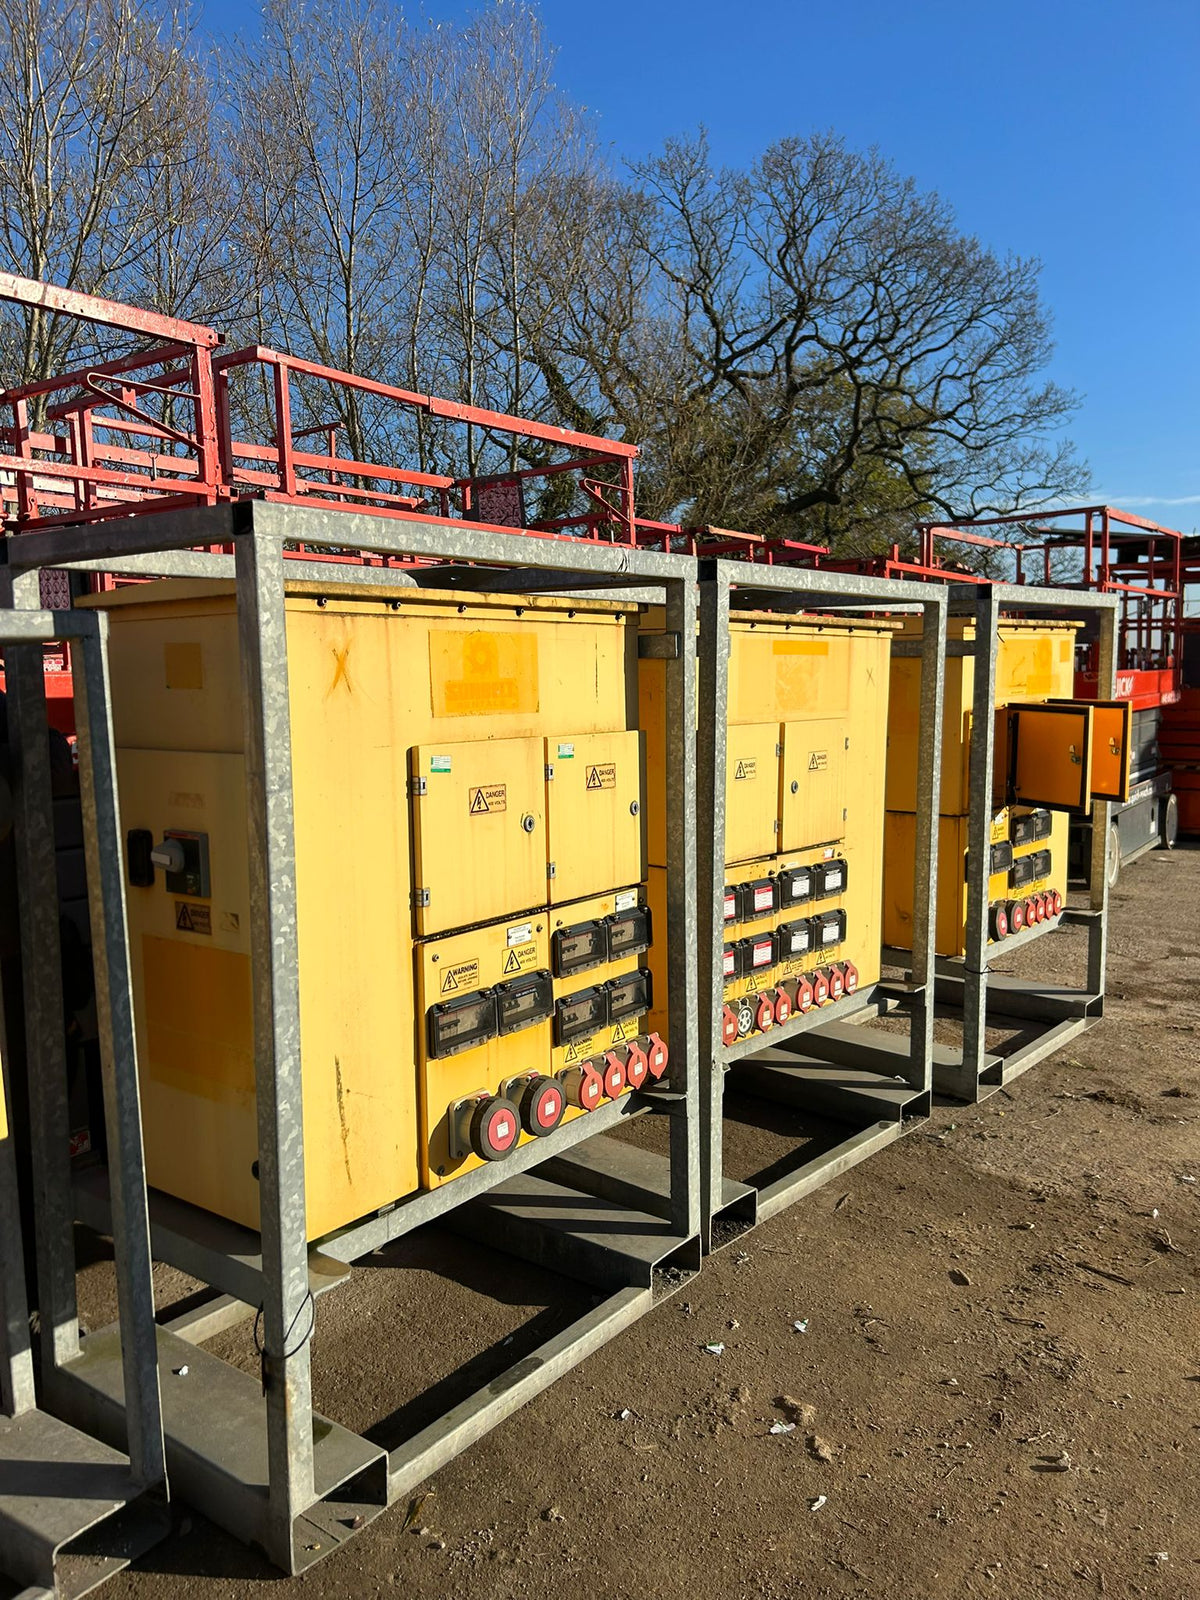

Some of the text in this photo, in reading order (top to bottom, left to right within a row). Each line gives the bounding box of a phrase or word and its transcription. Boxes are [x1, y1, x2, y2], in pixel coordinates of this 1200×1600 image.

[486, 790, 505, 799] DANGER
[517, 947, 536, 958] DANGER
[452, 963, 478, 976] WARNING
